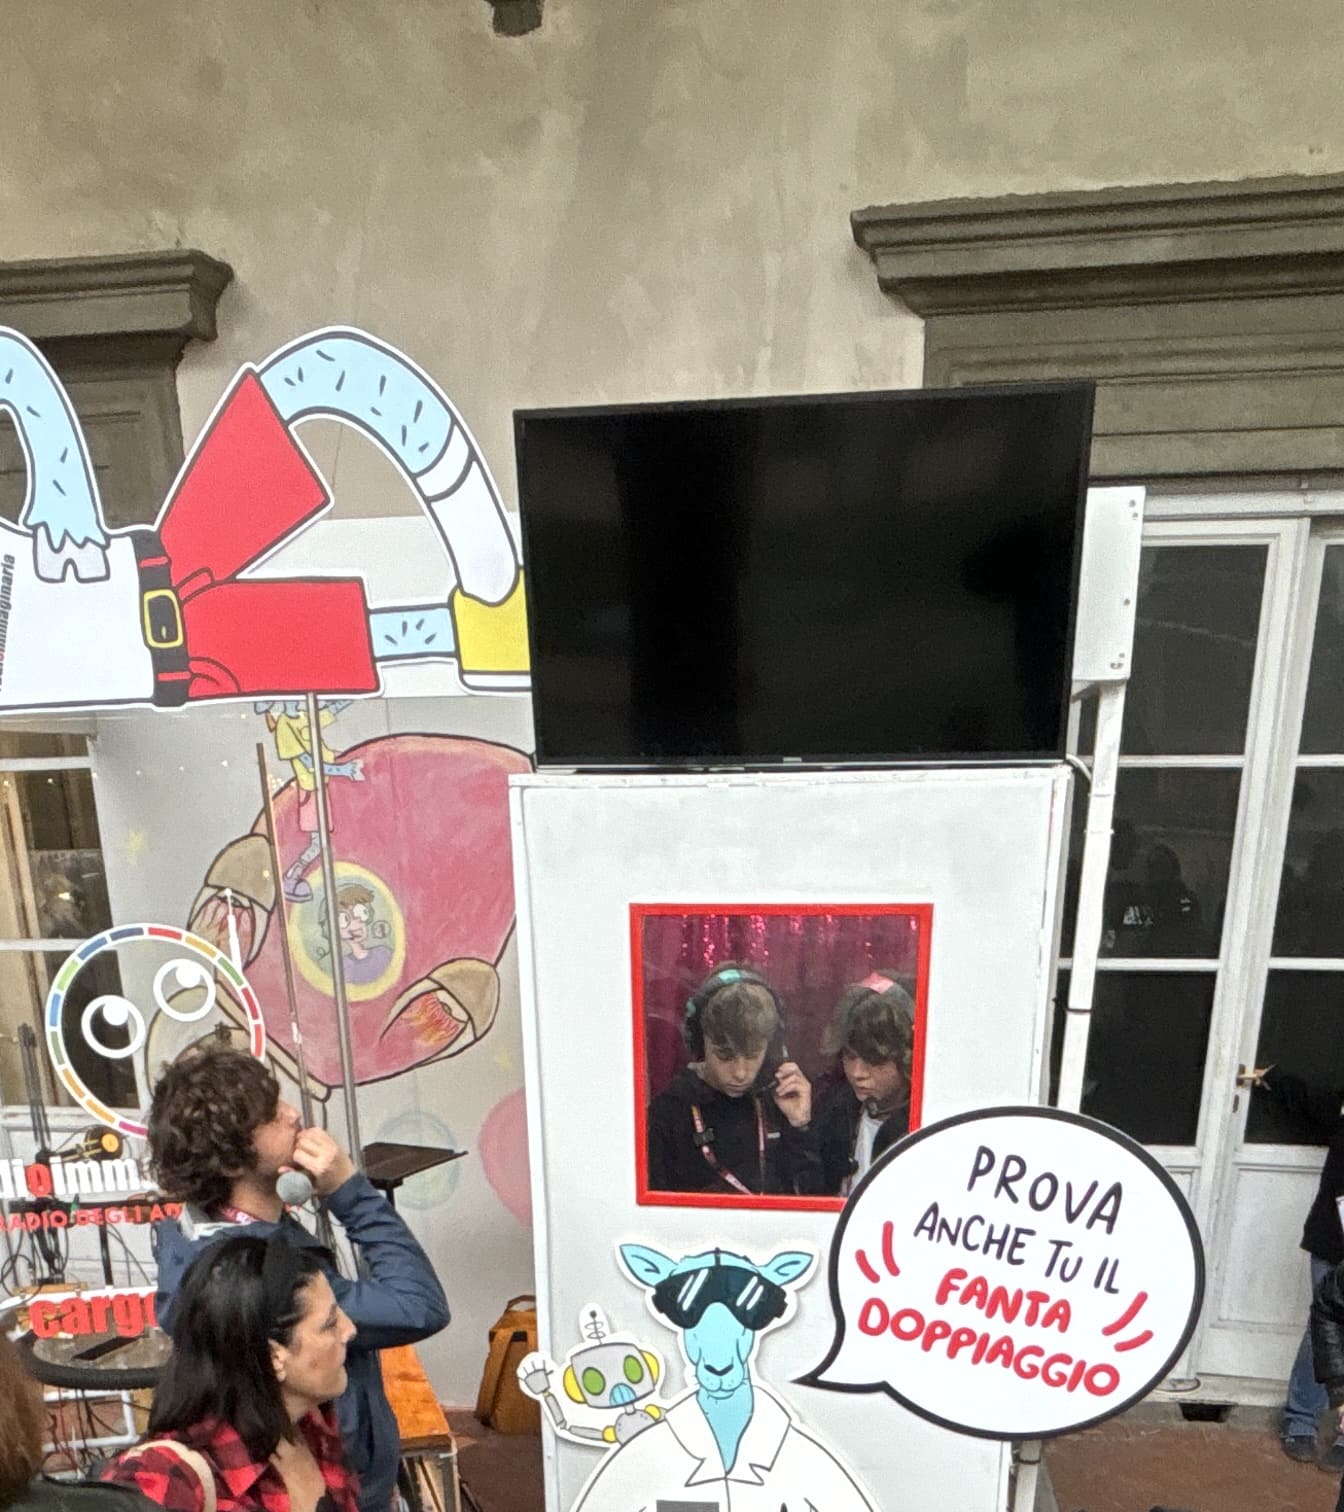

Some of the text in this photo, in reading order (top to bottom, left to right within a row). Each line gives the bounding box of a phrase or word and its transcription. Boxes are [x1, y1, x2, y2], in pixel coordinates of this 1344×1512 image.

[77, 1207, 143, 1227] DEGLI
[149, 1202, 183, 1222] AD
[967, 1145, 1123, 1235] PROVA
[913, 1201, 1120, 1295] ANCHE TU IL
[934, 1267, 1071, 1334] FANTA
[857, 1296, 1121, 1397] DOPPIAGGIO
